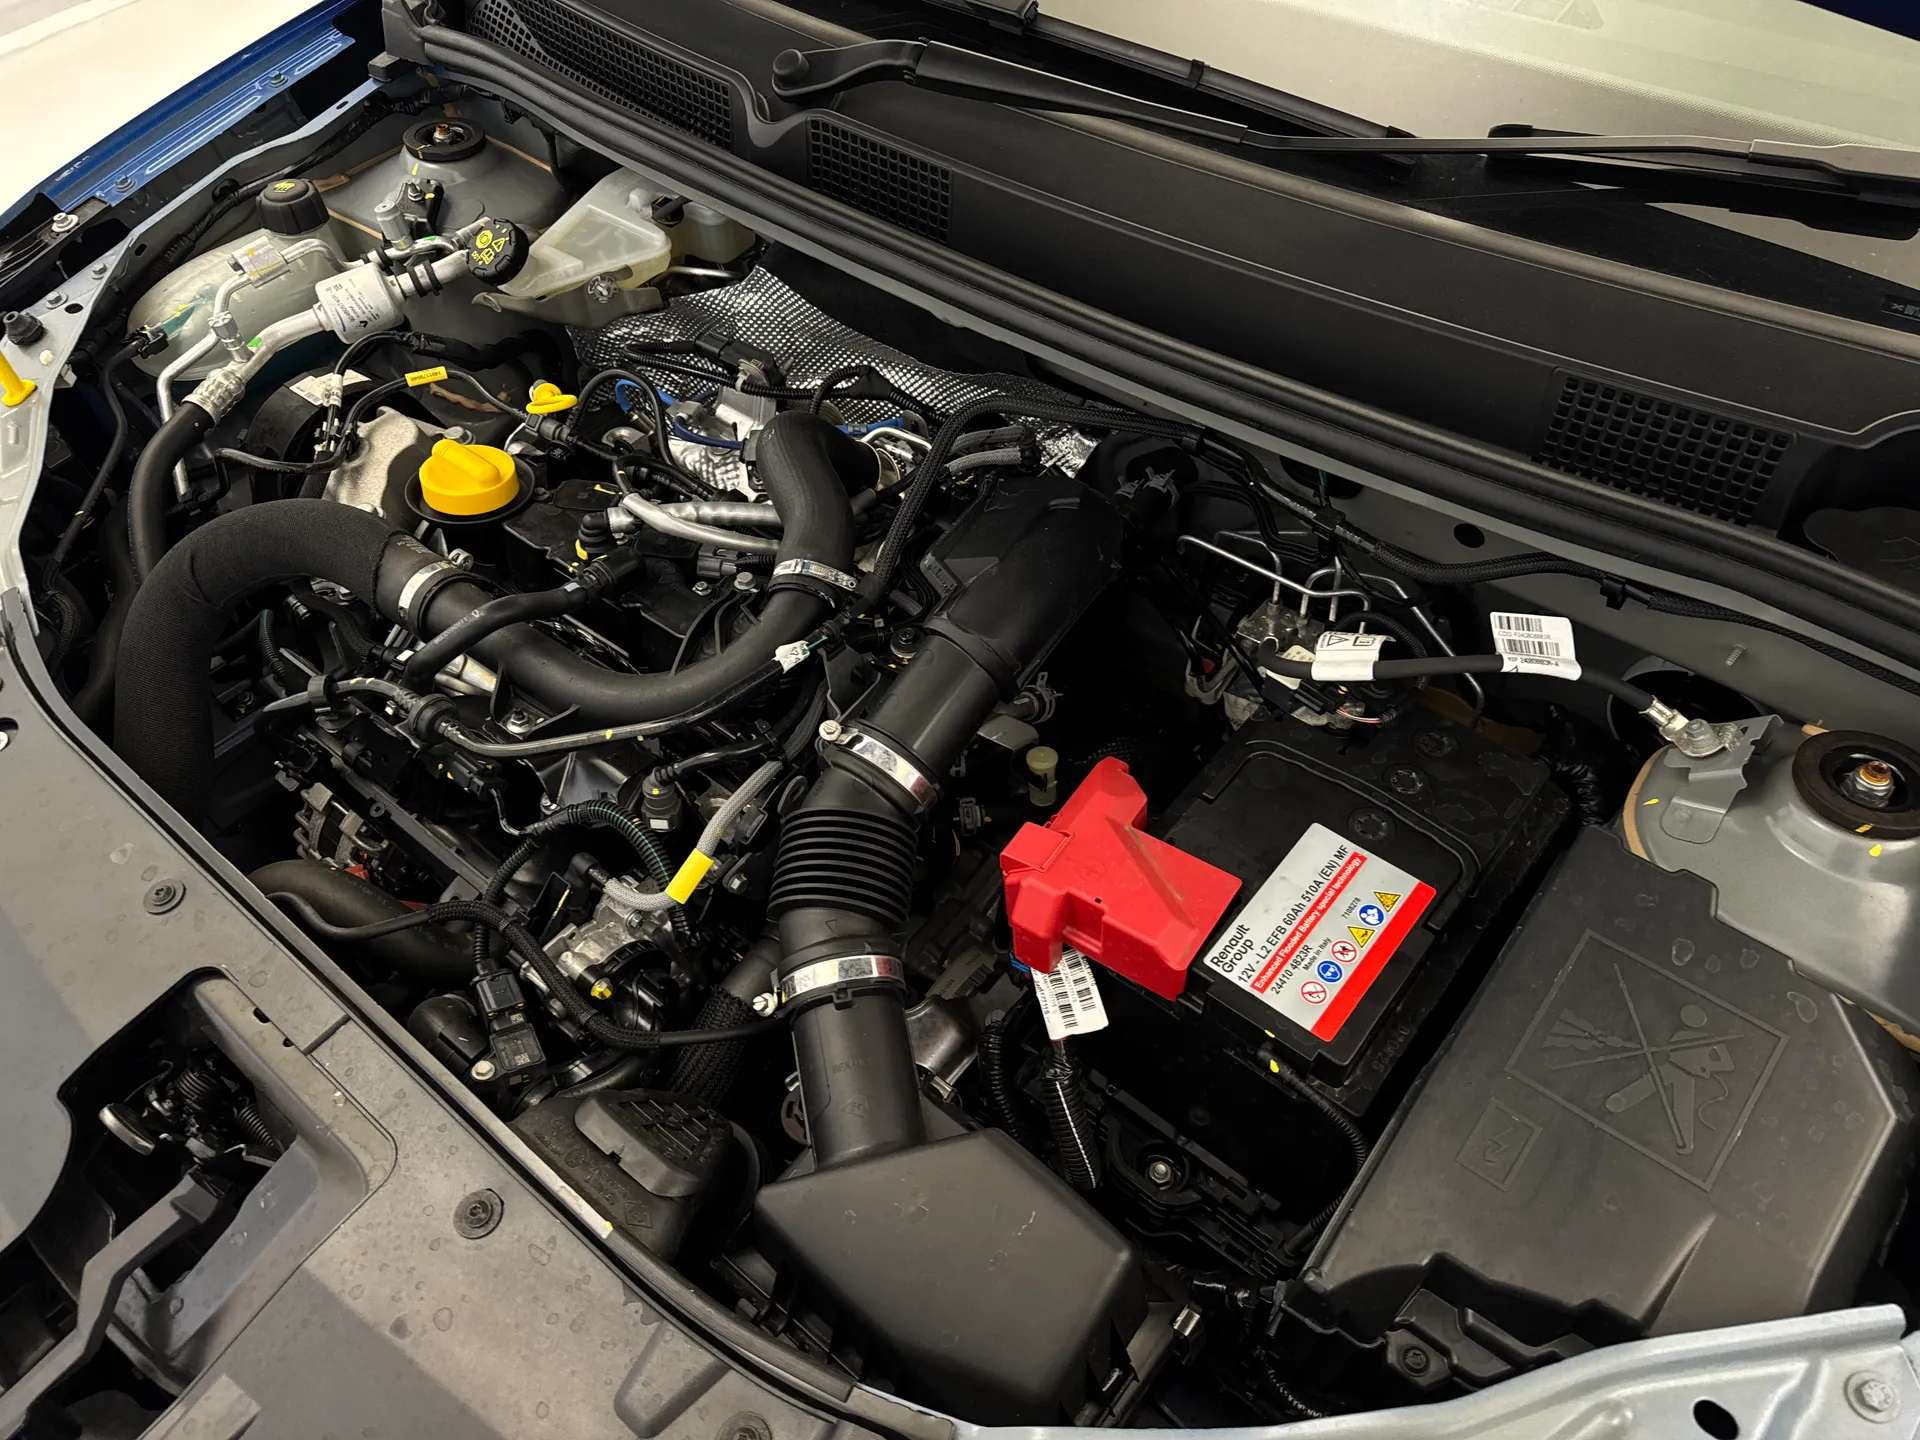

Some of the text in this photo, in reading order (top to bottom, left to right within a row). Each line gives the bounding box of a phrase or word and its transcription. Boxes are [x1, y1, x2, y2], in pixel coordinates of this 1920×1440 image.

[1238, 966, 1257, 984] 12V
[1257, 943, 1271, 960] L2
[1267, 925, 1287, 947] EFB
[1282, 900, 1306, 927] 60Ah
[1301, 878, 1324, 903] 510A
[1319, 858, 1341, 882] (EN)
[1333, 843, 1349, 861] MF
[1256, 856, 1362, 988] Enhanced Flooded Battery special technology
[1211, 923, 1250, 968] Renault
[1221, 938, 1255, 974] Group
[1271, 944, 1313, 995] 24410 4823R
[1302, 954, 1318, 972] Made
[1318, 936, 1332, 951] Italy
